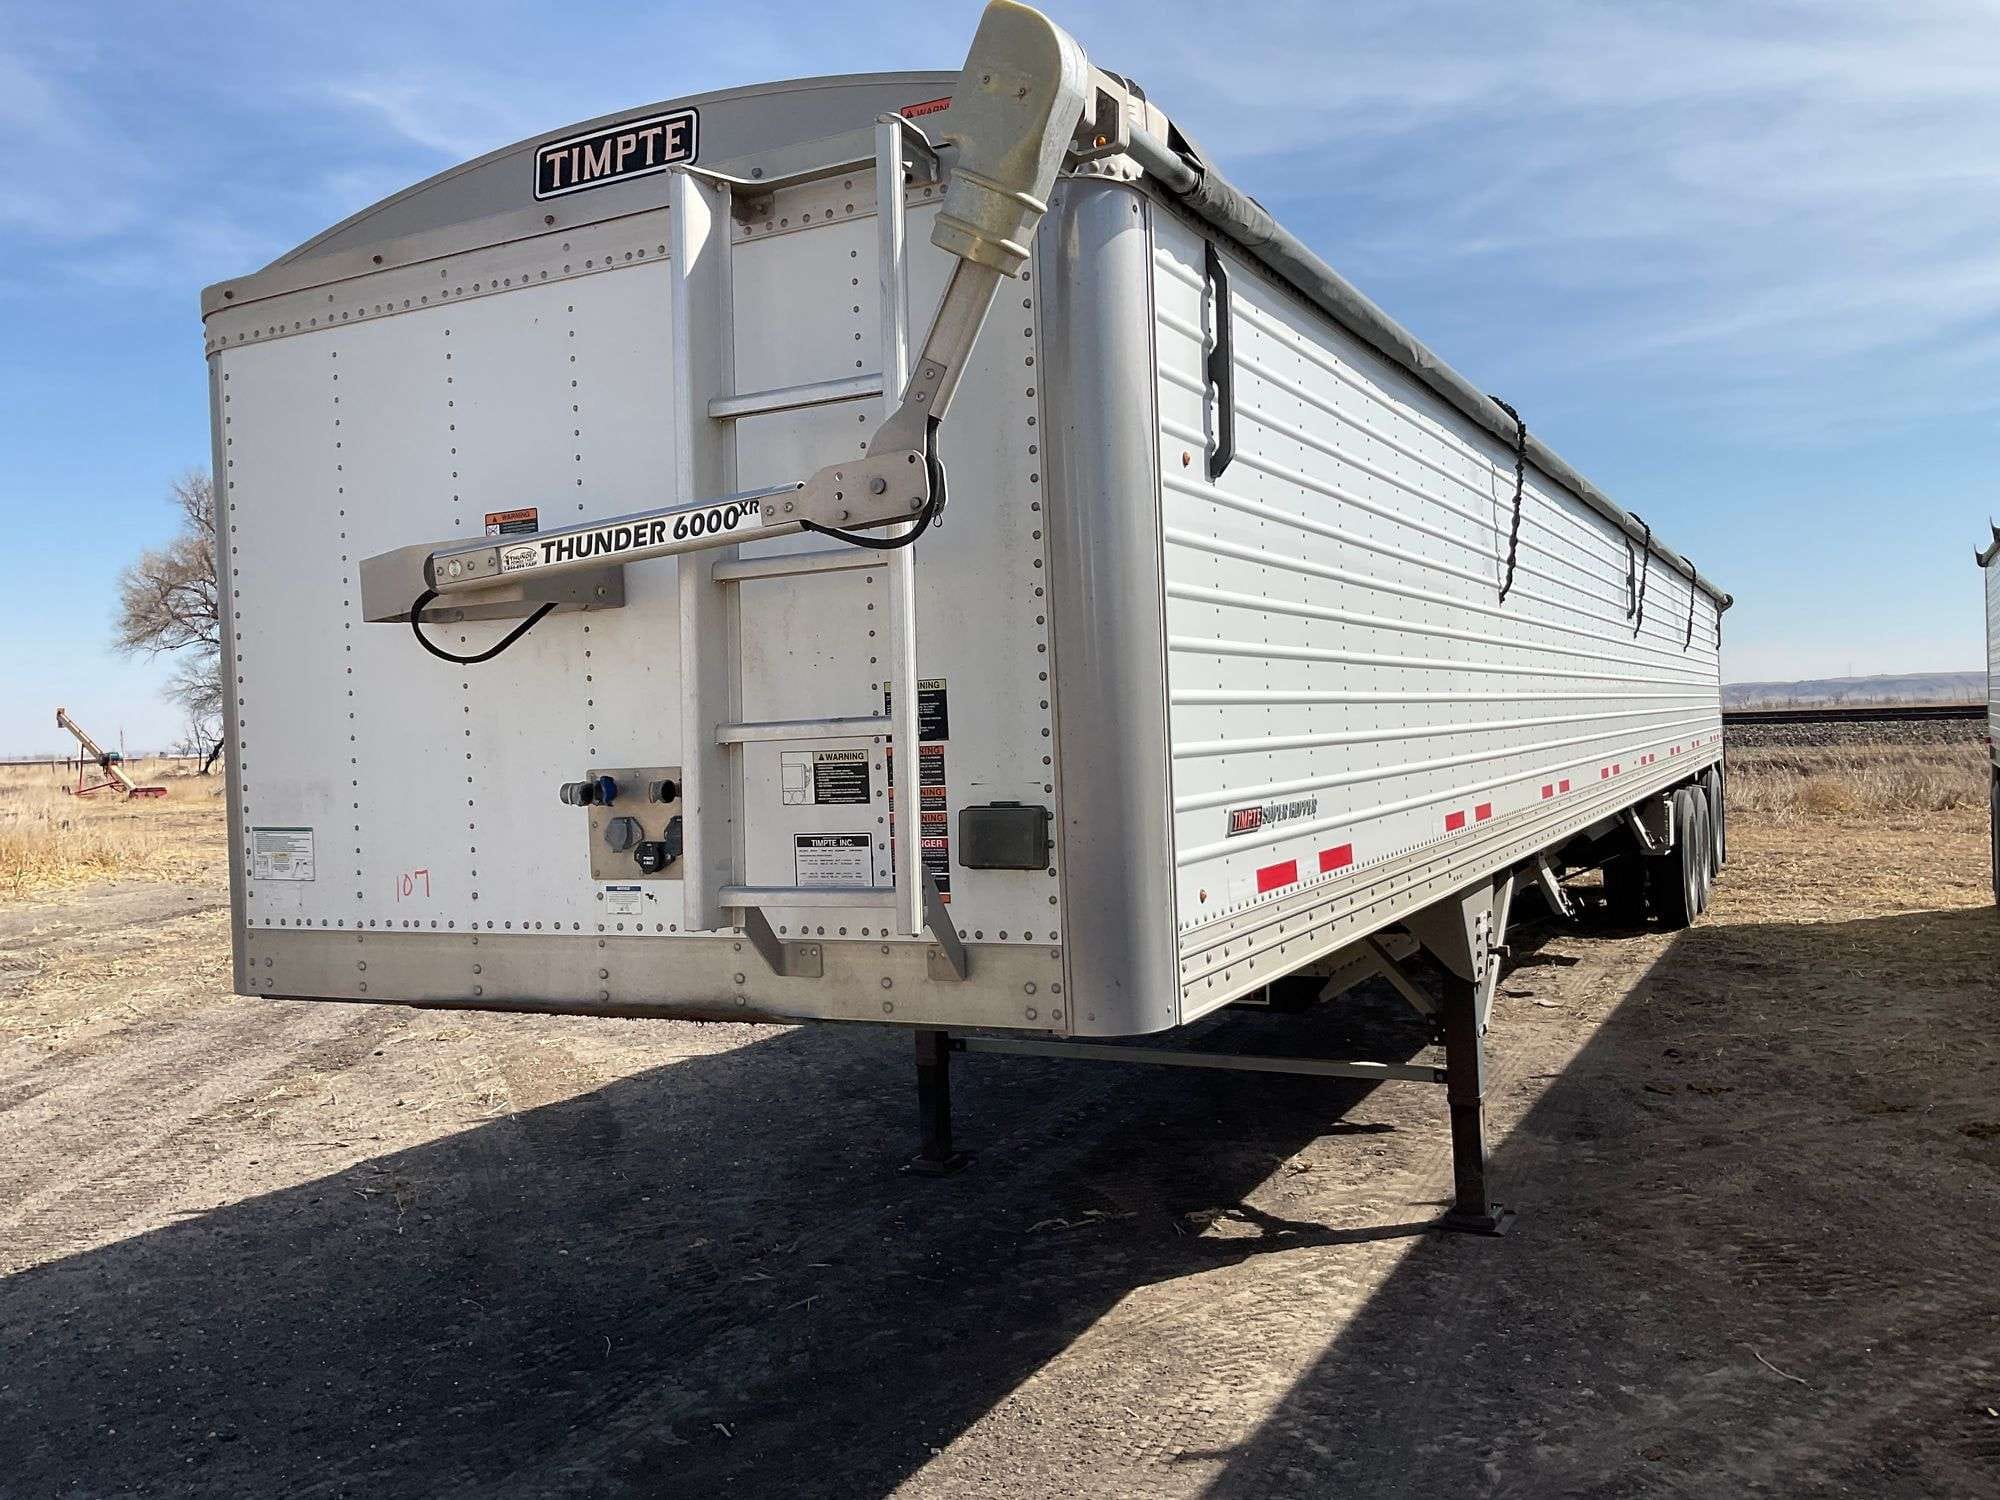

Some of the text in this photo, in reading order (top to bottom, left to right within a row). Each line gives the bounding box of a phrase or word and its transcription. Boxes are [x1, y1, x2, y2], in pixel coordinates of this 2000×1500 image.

[546, 120, 686, 188] TIMPTE
[541, 520, 666, 564] THUNDER
[918, 681, 940, 690] NING
[919, 747, 941, 755] NING
[825, 752, 864, 761] WARNING
[920, 788, 942, 796] NING
[921, 814, 944, 822] NING
[1233, 808, 1262, 830] TIMPTE
[811, 839, 838, 847] TIMPTE
[396, 870, 430, 903] 107
